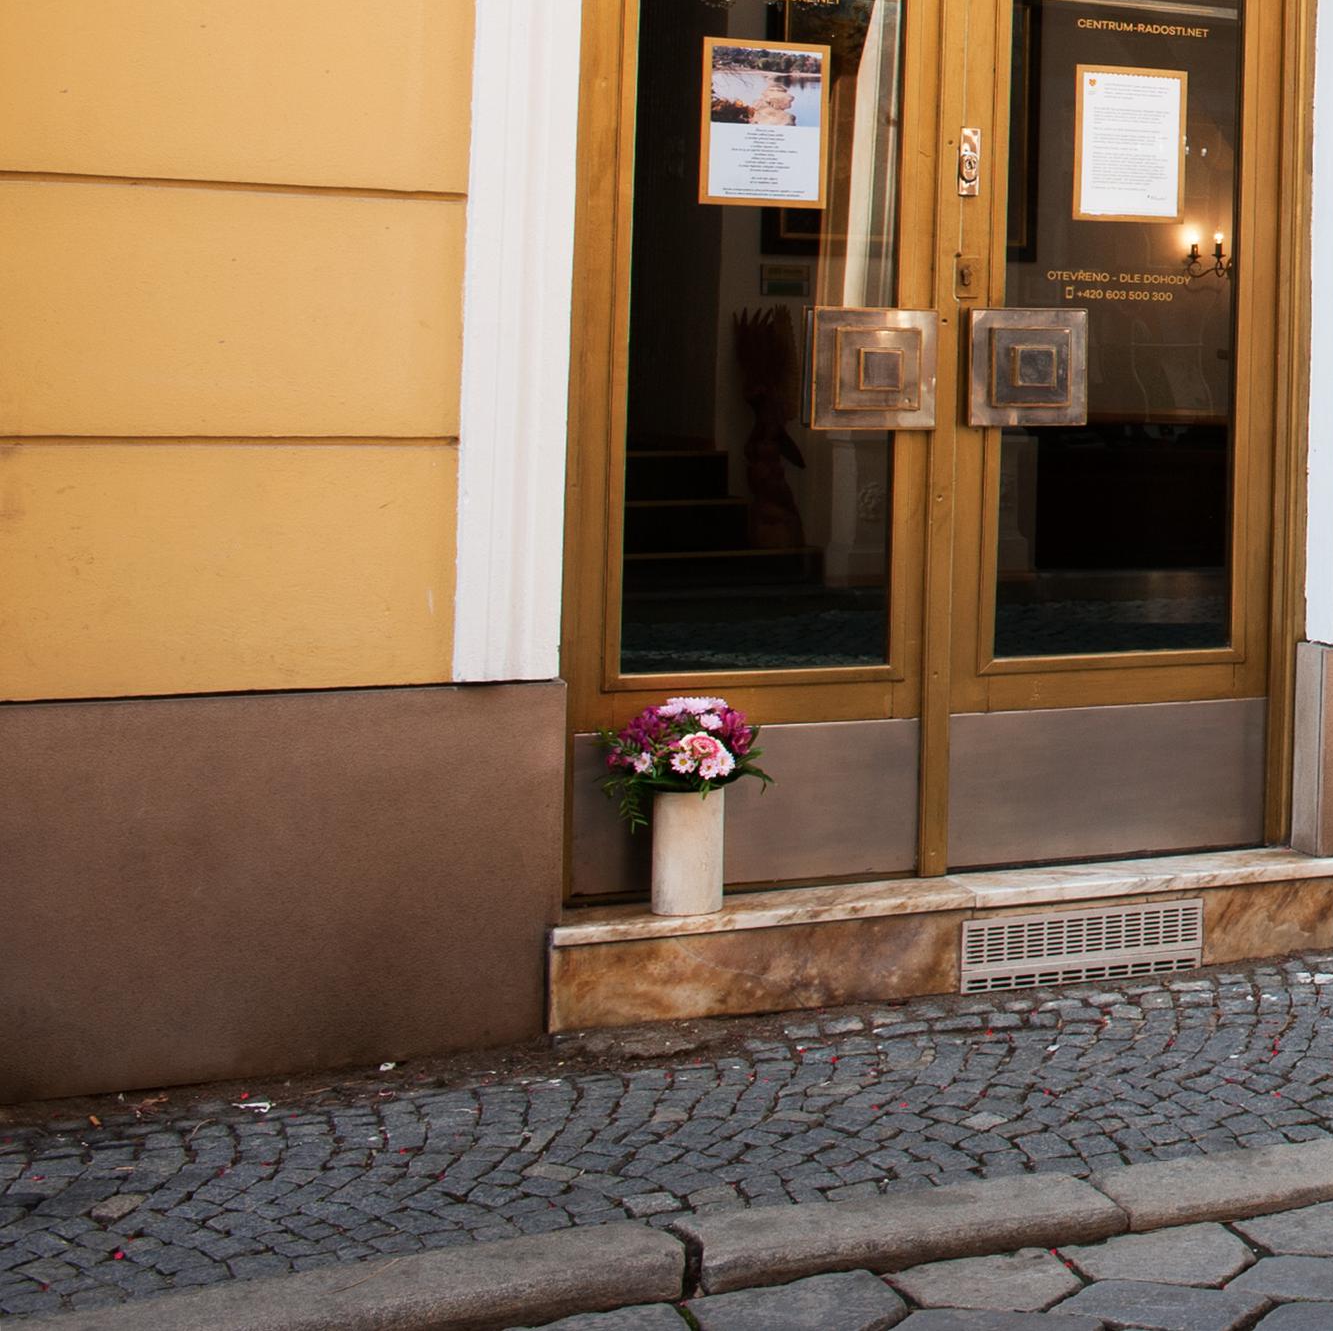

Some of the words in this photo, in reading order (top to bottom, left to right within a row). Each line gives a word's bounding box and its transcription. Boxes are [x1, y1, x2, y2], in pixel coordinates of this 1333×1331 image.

[1077, 19, 1209, 38] CENTRUM-RADOSTI.NET
[1047, 270, 1110, 282] OTEVŘENO
[1119, 273, 1141, 283] DLE
[1143, 274, 1191, 285] DOHODY
[1077, 290, 1103, 300] +420
[1105, 290, 1127, 300] 603
